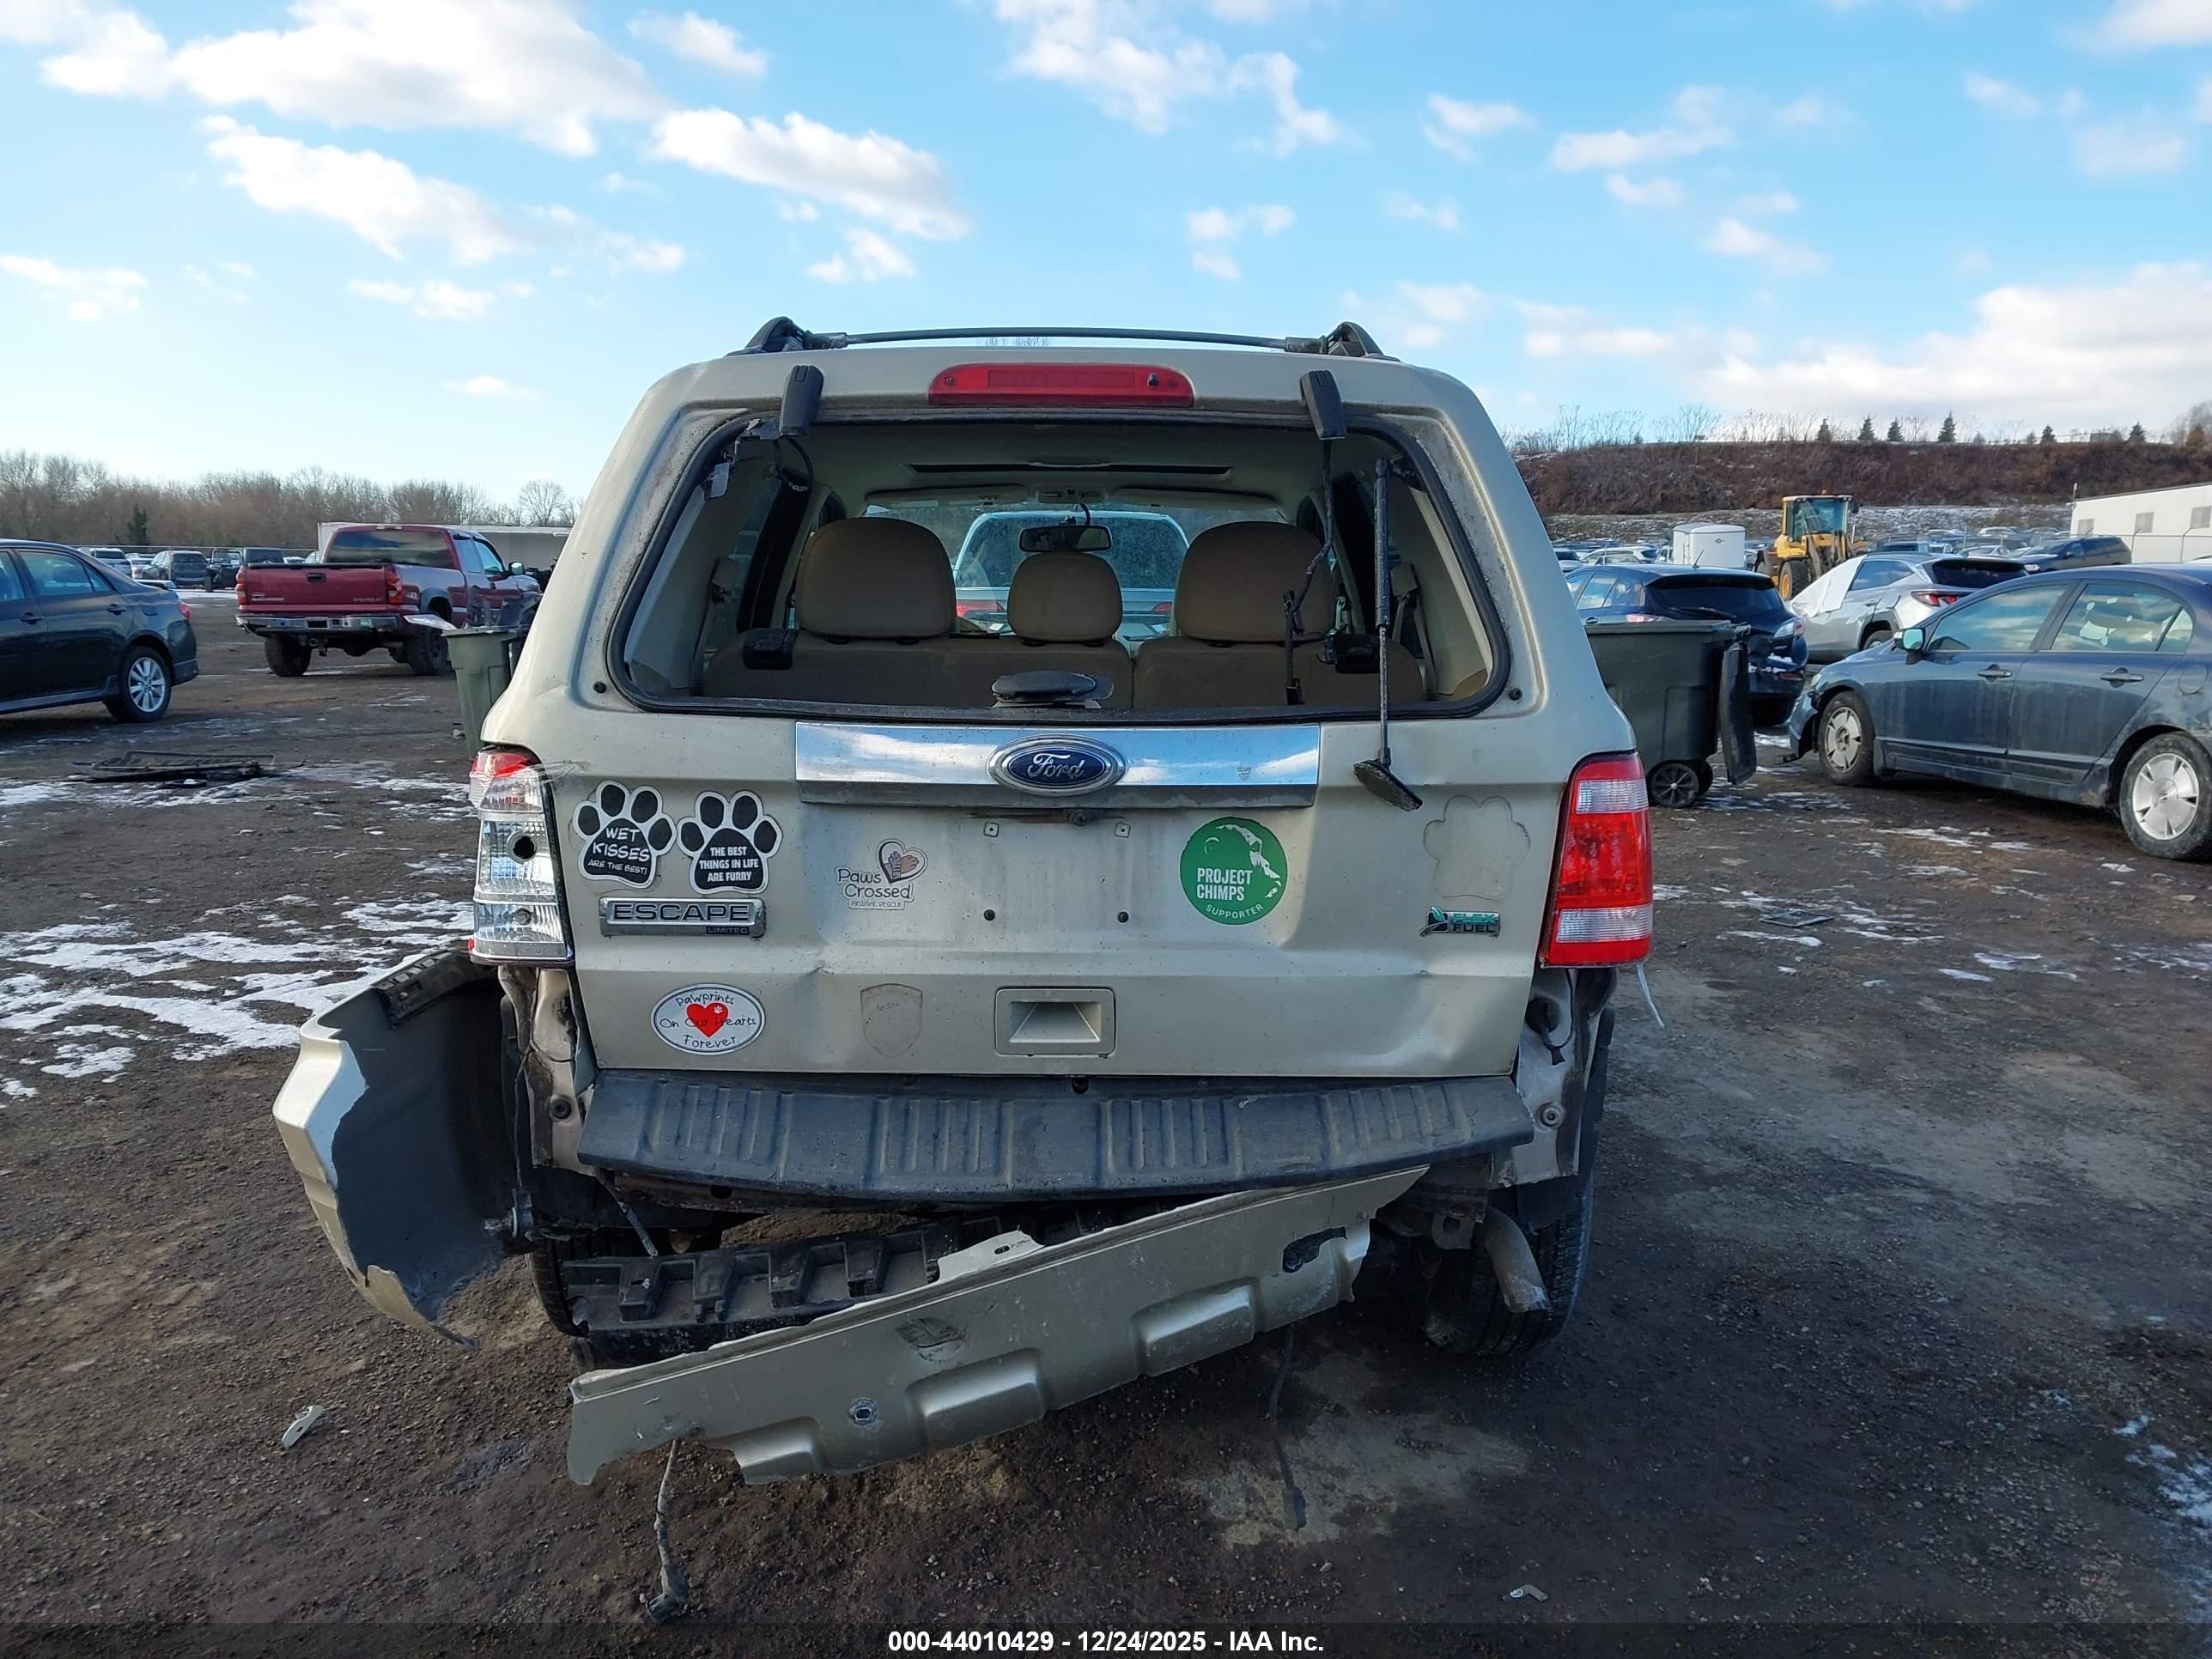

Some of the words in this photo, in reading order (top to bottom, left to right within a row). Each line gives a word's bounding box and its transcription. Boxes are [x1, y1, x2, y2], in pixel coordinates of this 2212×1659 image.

[1027, 753, 1086, 779] Ford
[605, 826, 641, 842] WET
[592, 842, 651, 862] KISSES
[710, 847, 726, 856] THE
[727, 847, 747, 856] BEST
[587, 859, 605, 868] ARE
[607, 862, 623, 871] THE
[625, 864, 647, 875] BEST!
[699, 860, 729, 869] THINGS
[731, 859, 741, 868] IN
[743, 859, 759, 868] LIFE
[707, 872, 725, 882] ARE
[726, 871, 752, 881] FURRY
[837, 868, 882, 884] Paws
[1196, 867, 1253, 884] PROJECT
[844, 884, 911, 899] Crossed
[1196, 884, 1244, 901] CHIMPS
[613, 904, 750, 921] ESCAPE
[1205, 903, 1264, 919] SUPPORTER
[1451, 914, 1498, 923] FLEX
[1453, 924, 1495, 933] FUEL
[659, 1018, 679, 1028] On
[685, 1017, 708, 1028] Our
[715, 1016, 757, 1027] Hearts
[684, 1034, 737, 1048] Forever
